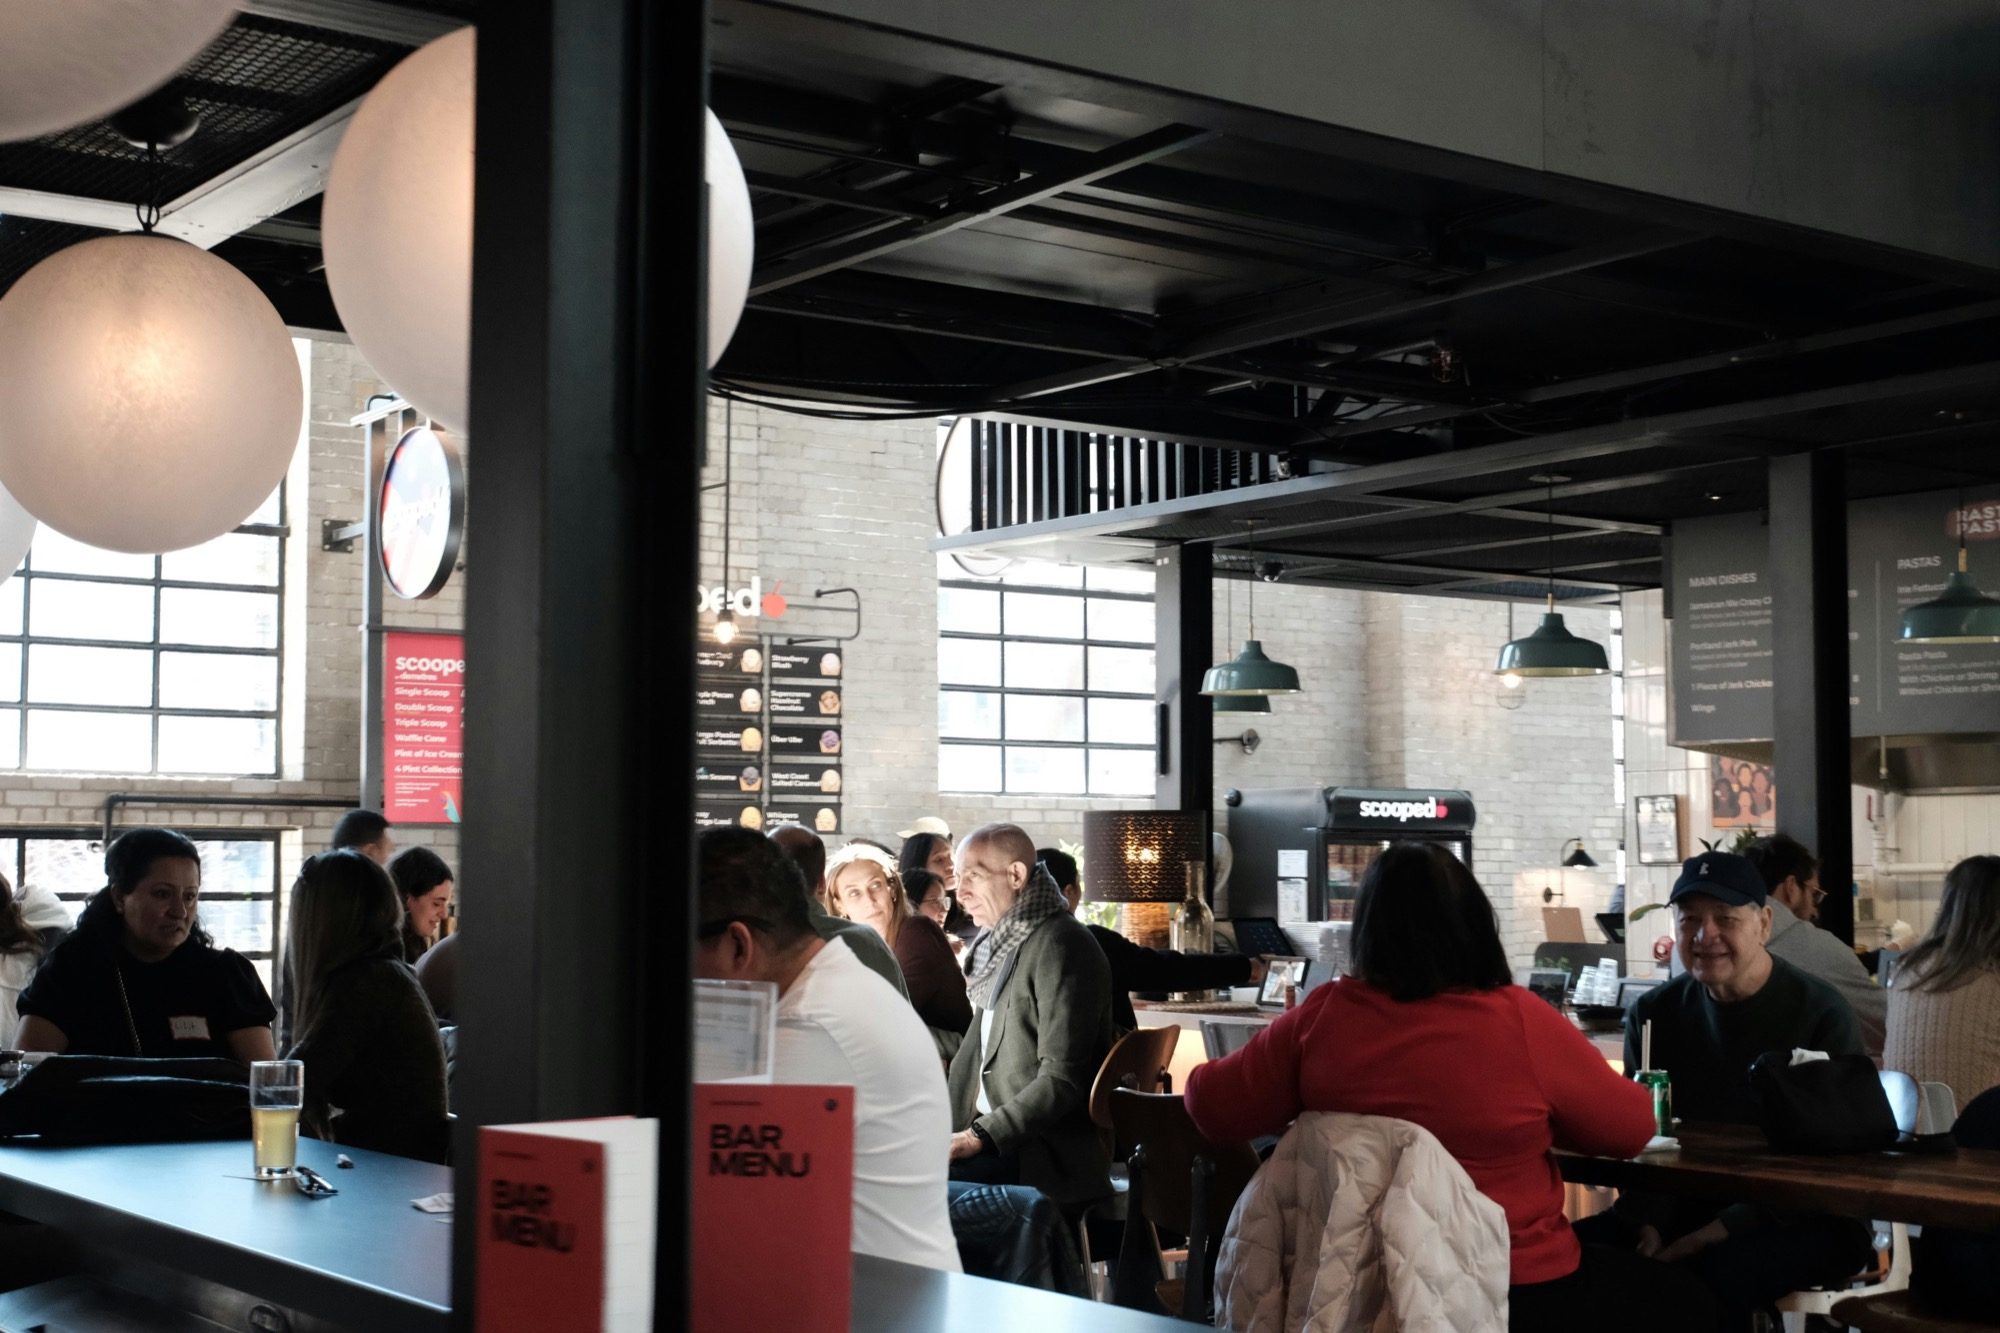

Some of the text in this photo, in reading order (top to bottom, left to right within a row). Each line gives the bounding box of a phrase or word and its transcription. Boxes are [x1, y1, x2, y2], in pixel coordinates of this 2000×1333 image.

[1897, 556, 1941, 570] PASTAS
[1689, 573, 1757, 588] MAIN DISHES
[772, 654, 809, 664] Strawberry
[395, 656, 465, 676] scoope
[1920, 674, 1954, 682] Chicken
[394, 687, 421, 697] Single
[423, 689, 450, 697] Scoop
[1934, 685, 1968, 693] Chicken
[394, 703, 425, 712] Double
[427, 704, 454, 713] Scoop
[770, 704, 805, 712] Chocolate
[1691, 704, 1715, 713] Wings
[394, 718, 447, 728] Triple Scoop
[394, 734, 447, 743] Waffle Cone
[394, 749, 412, 758] Pint
[424, 750, 437, 758] Ice
[402, 765, 420, 773] Pint
[421, 766, 463, 774] Collection
[1360, 796, 1436, 822] scooped
[711, 1122, 782, 1150] BAR
[709, 1150, 810, 1178] MENU
[492, 1179, 551, 1215] BAR
